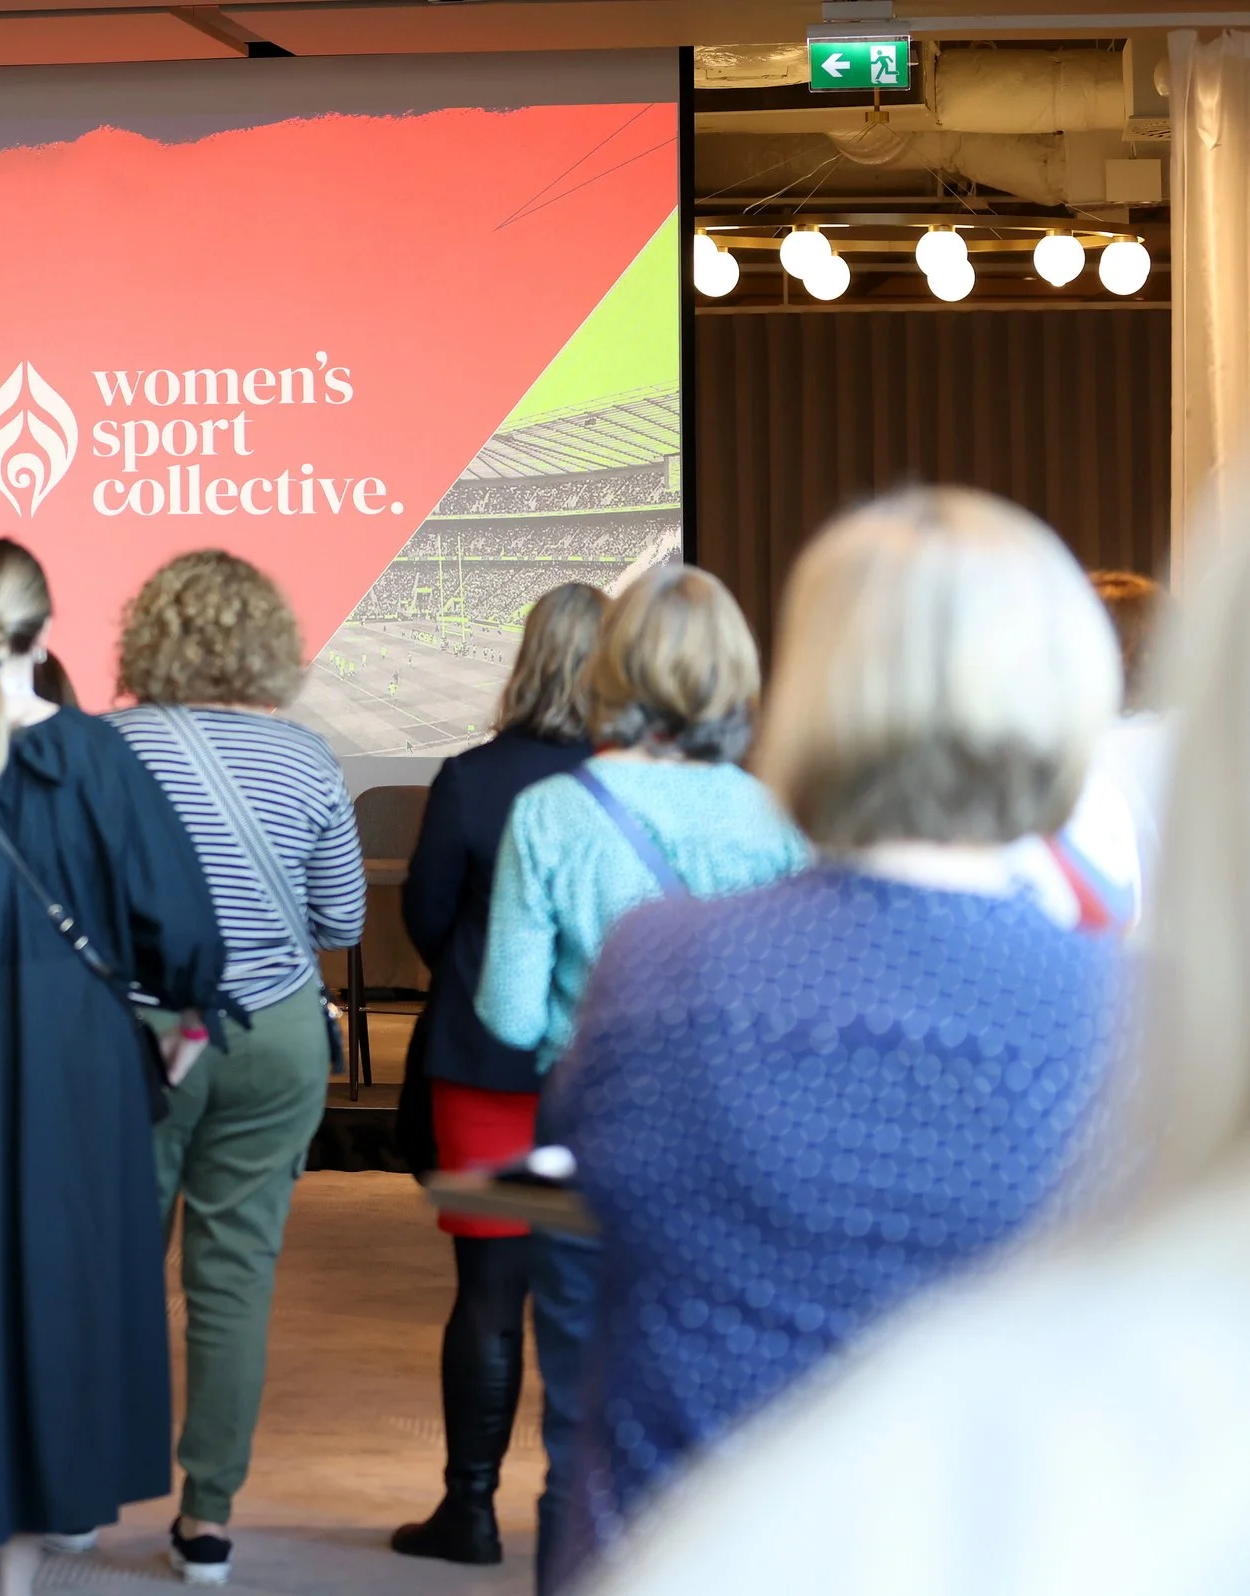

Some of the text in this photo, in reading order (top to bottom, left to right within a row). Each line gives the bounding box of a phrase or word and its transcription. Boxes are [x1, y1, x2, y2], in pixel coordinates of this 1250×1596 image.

[91, 350, 354, 406] women's
[92, 410, 255, 473] sport
[92, 463, 405, 517] collective.
